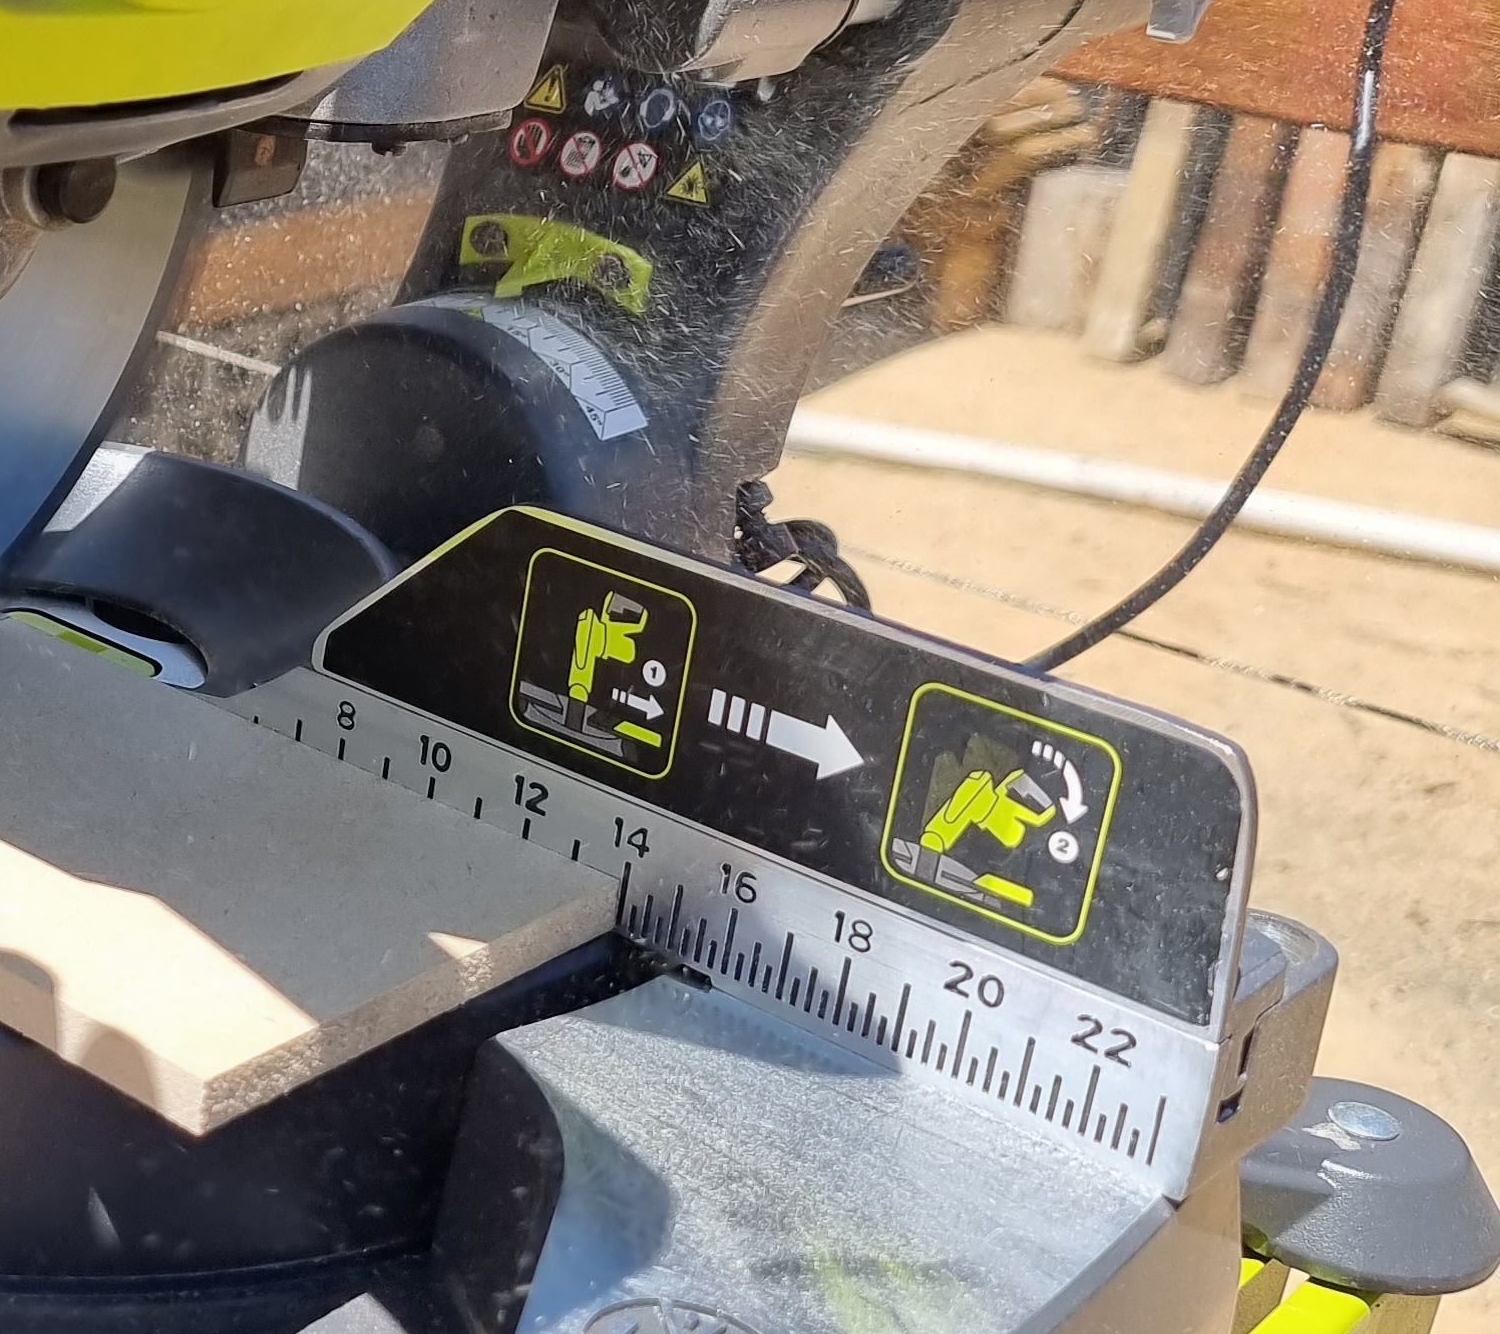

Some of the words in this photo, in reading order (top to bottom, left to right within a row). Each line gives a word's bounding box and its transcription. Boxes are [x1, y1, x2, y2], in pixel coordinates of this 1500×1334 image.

[650, 666, 658, 679] 1
[1056, 838, 1070, 855] 2
[336, 700, 357, 731] 8
[419, 734, 452, 773] 10
[514, 774, 549, 817] 12
[614, 816, 650, 859] 14
[721, 862, 757, 904] 16
[834, 910, 874, 954] 18
[943, 960, 1005, 1009] 20
[1070, 1014, 1137, 1069] 22
